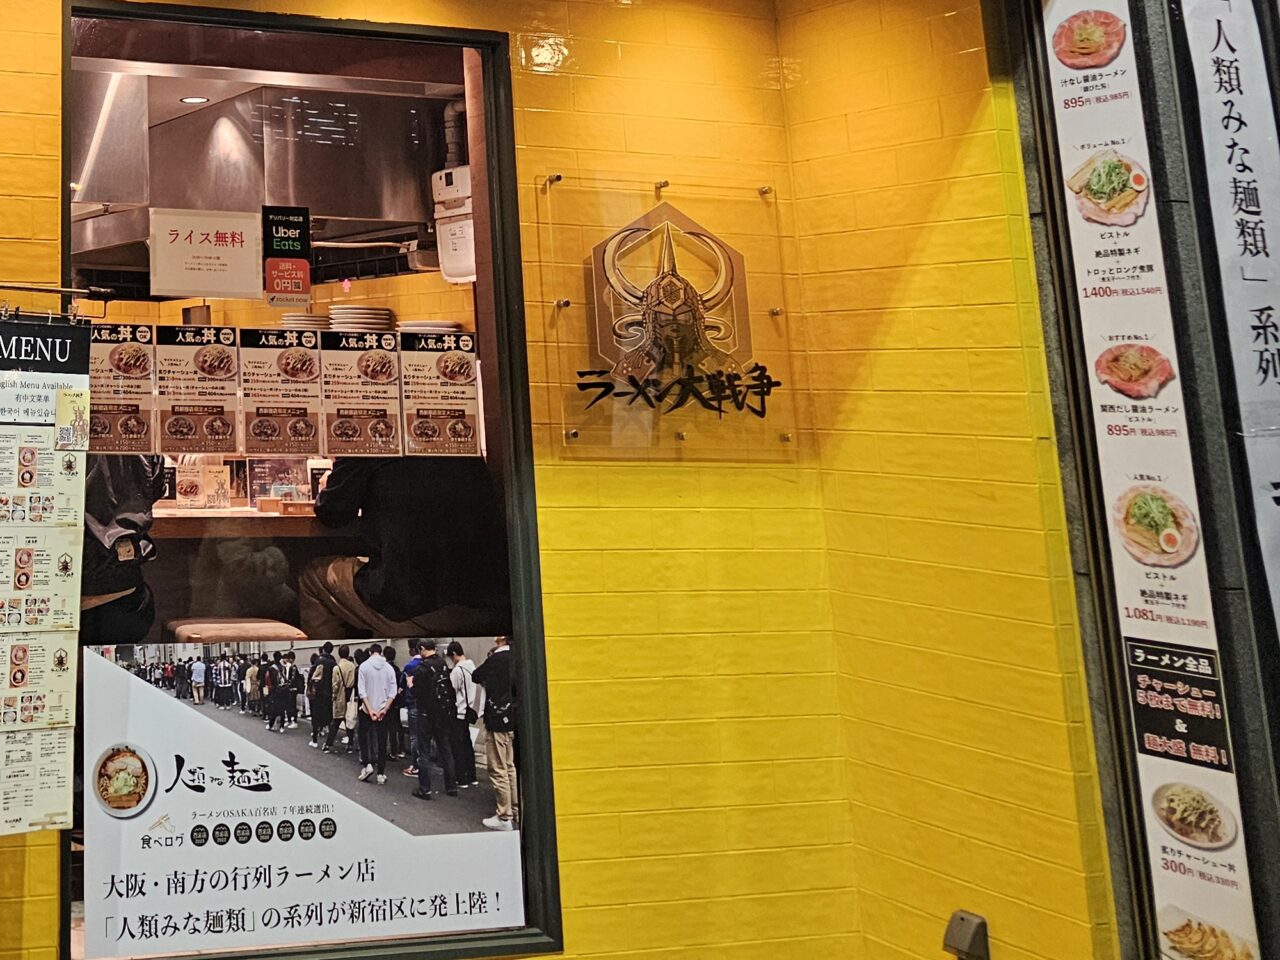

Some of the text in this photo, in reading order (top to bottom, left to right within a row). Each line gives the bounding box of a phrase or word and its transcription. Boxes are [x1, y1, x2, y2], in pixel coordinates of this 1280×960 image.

[169, 229, 245, 248] ライス無料
[272, 226, 301, 238] Uber
[273, 239, 301, 251] Eats
[274, 280, 292, 291] 0円
[91, 325, 133, 342] 人気の丼
[176, 328, 217, 344] 人気の丼
[259, 331, 299, 347] 人気の丼
[340, 333, 379, 349] 人気の丼
[419, 335, 457, 350] 人気の丼
[19, 381, 40, 389] Menu
[41, 381, 73, 390] Available
[576, 362, 782, 420] ラーメン大戦争
[0, 407, 20, 416] 한국어
[1134, 648, 1212, 675] ラーメン全品
[1136, 674, 1216, 698] チャーシュー
[191, 807, 278, 820] ラーメンOSAKA百名店
[141, 833, 186, 849] 食べログ
[102, 858, 376, 900] 大阪・南方の行列ラーメン店
[104, 891, 501, 942] 「人類みな麺類」の系列が新宿区に発上陸！
